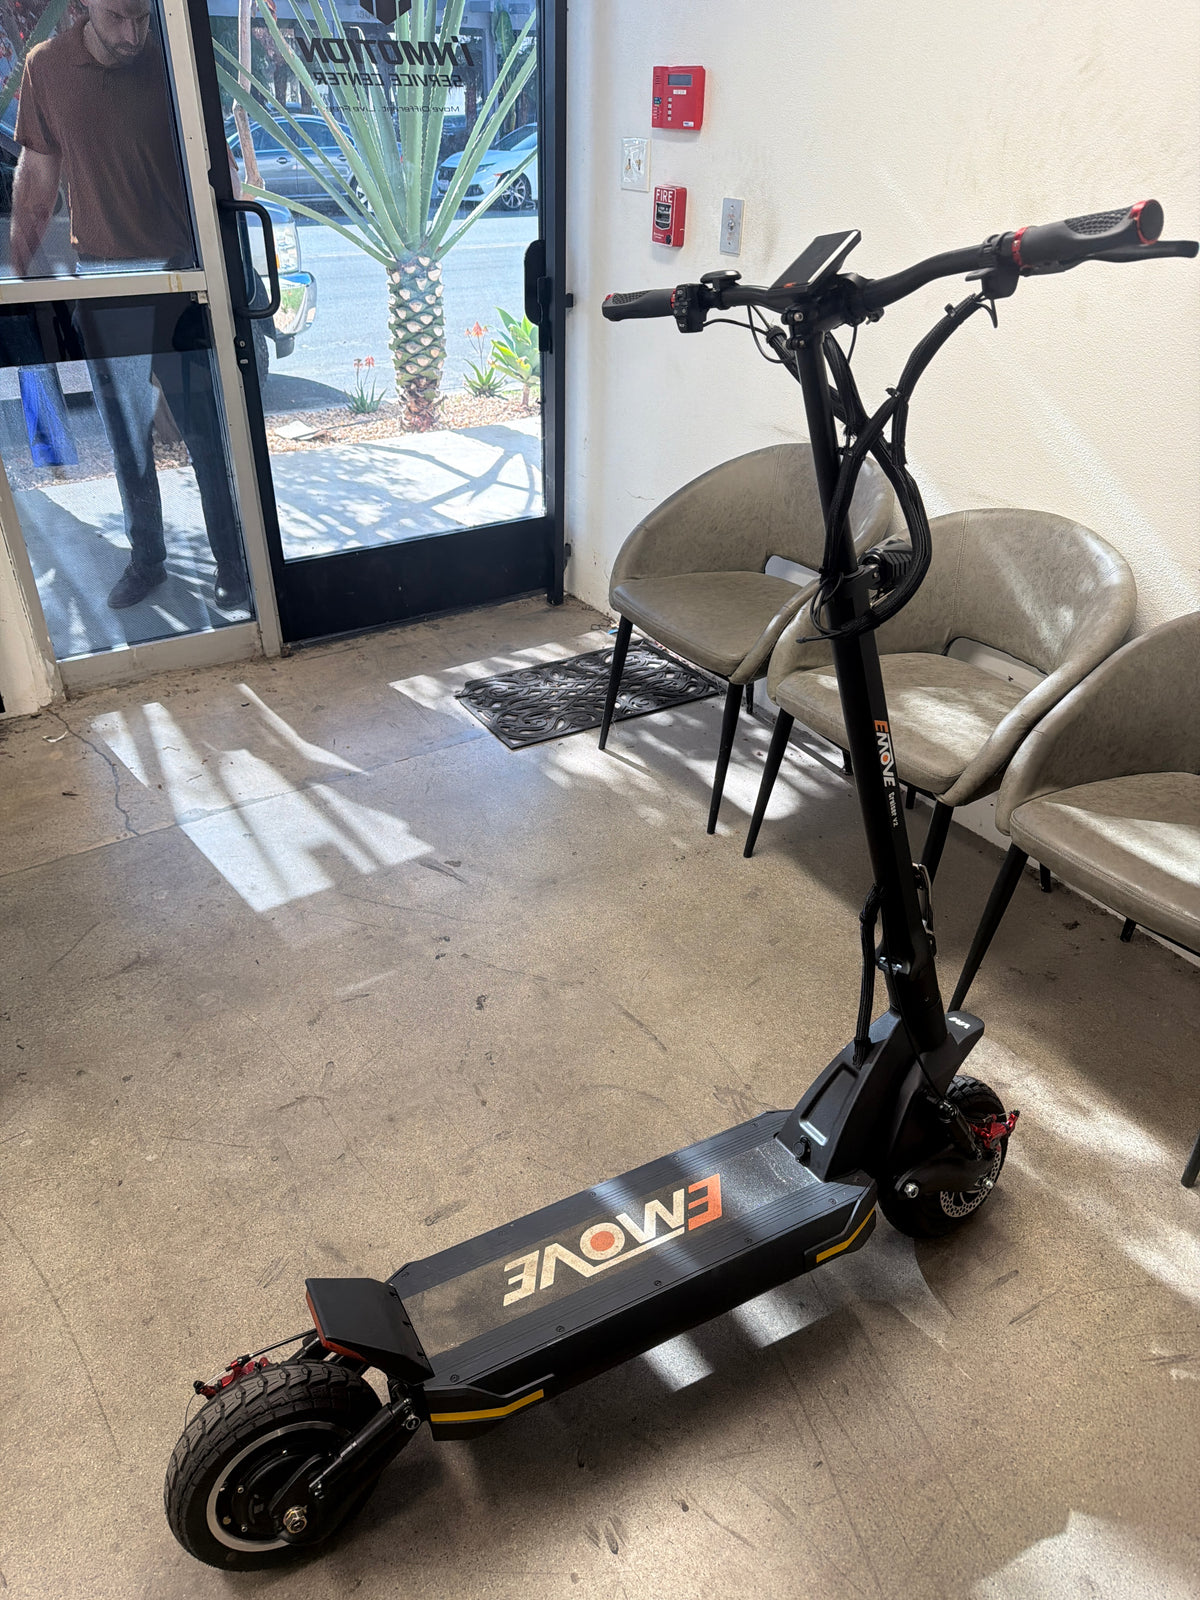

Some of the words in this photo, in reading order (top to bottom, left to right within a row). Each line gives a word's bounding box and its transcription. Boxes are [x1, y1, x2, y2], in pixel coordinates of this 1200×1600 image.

[655, 188, 674, 203] FIRE
[874, 720, 896, 788] EMOVE
[503, 1173, 723, 1307] EMOVE
